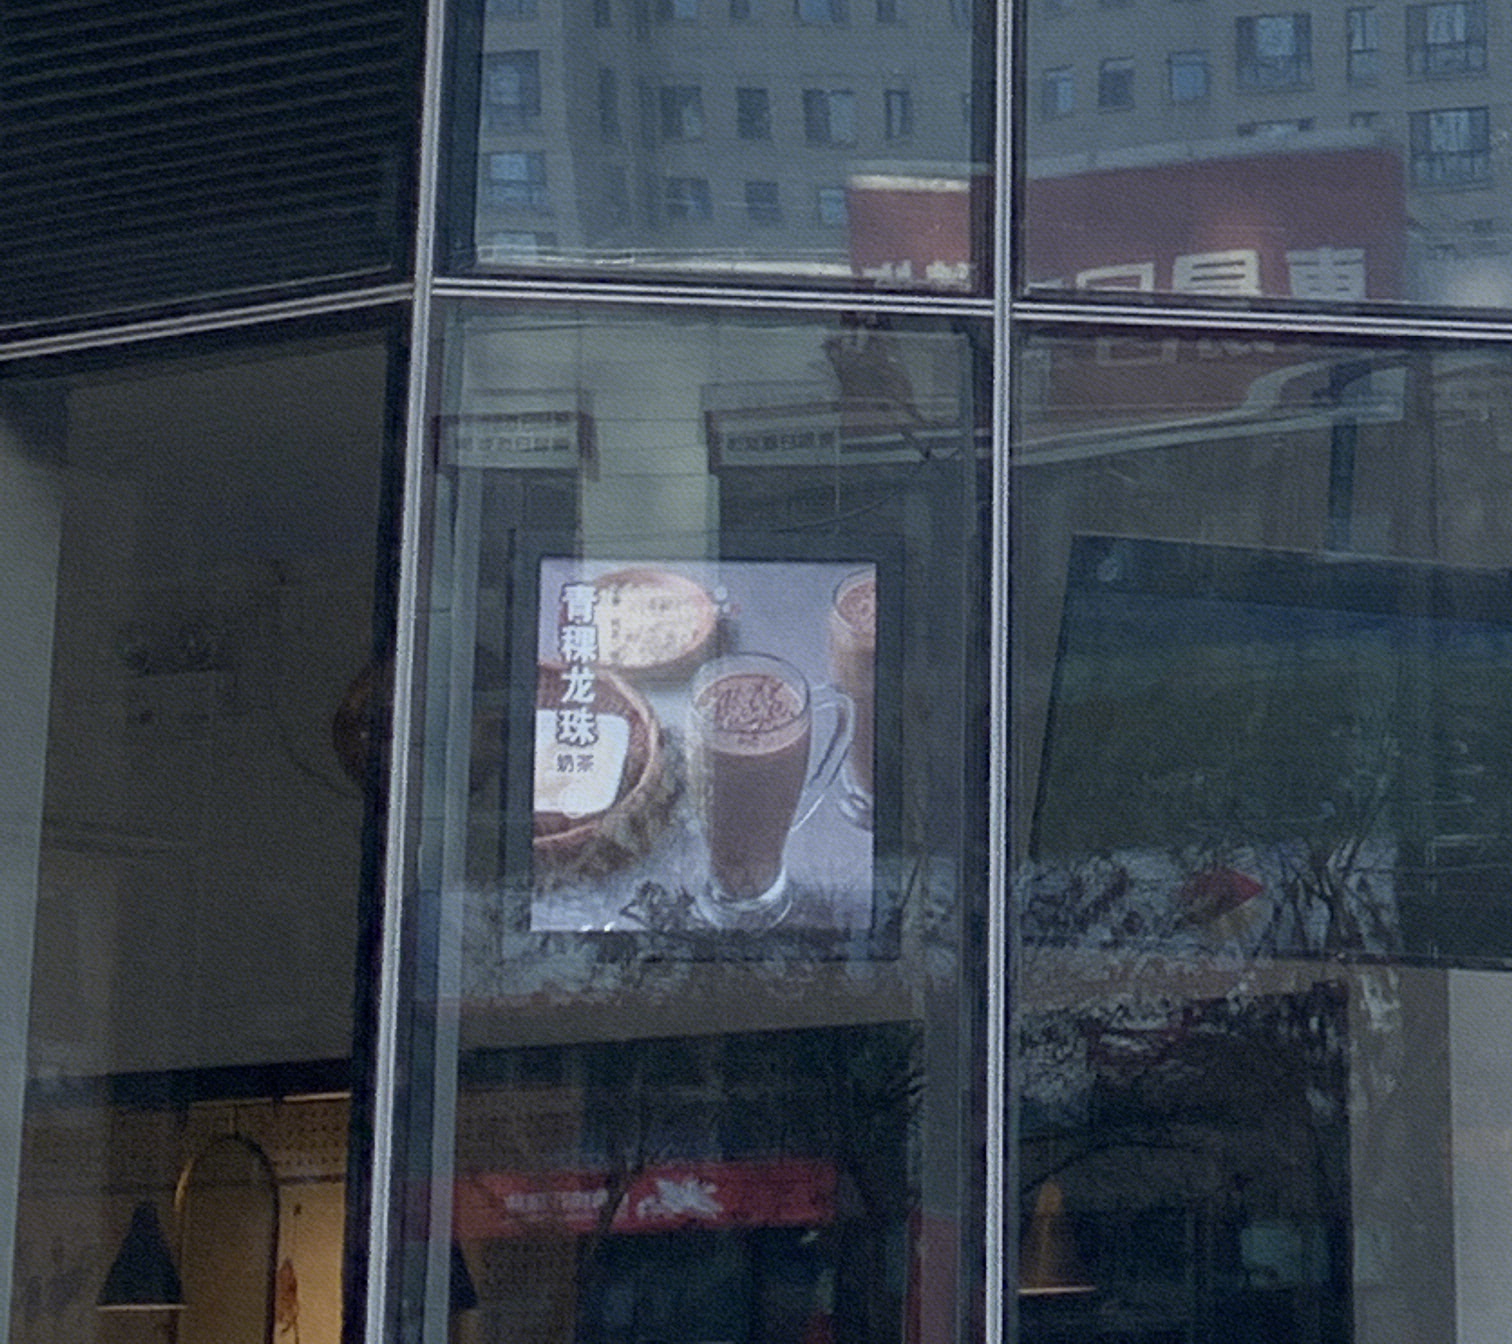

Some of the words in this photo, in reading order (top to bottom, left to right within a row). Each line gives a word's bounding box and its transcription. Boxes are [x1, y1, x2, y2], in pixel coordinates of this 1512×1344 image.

[559, 583, 599, 747] 青稞龙珠
[556, 753, 595, 773] 奶茶
